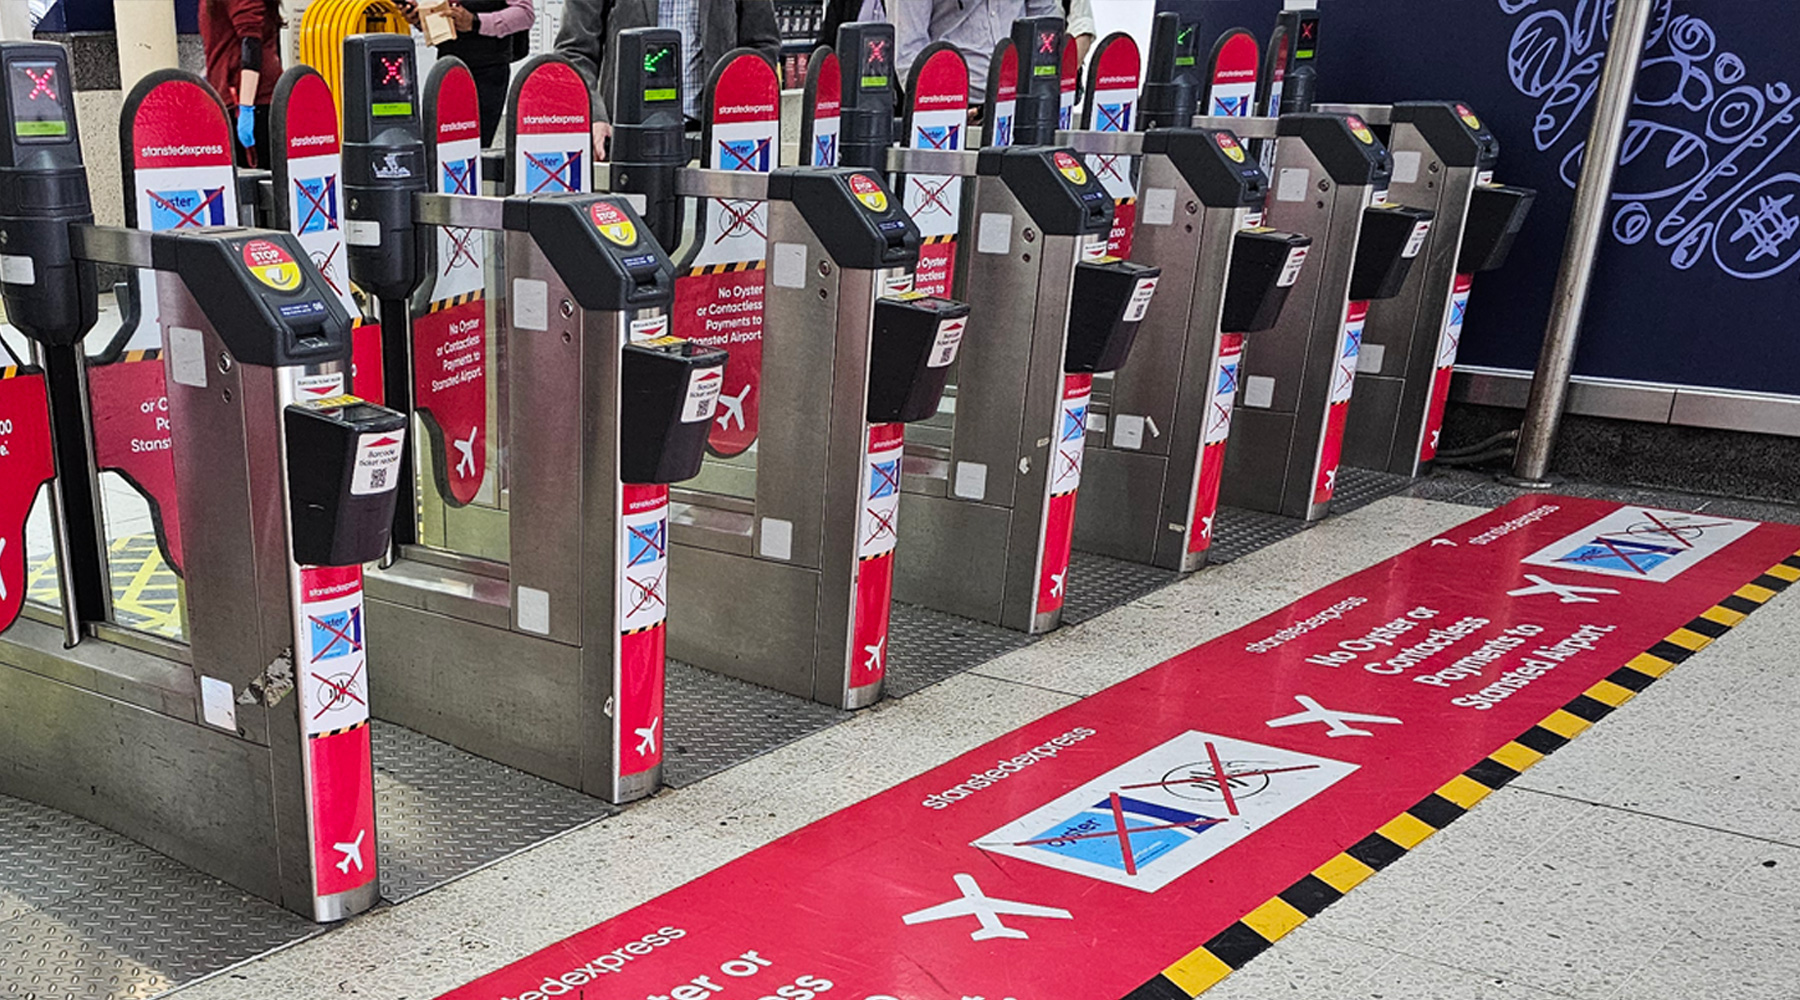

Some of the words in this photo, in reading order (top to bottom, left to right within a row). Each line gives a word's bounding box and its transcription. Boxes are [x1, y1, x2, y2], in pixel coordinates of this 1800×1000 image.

[523, 114, 585, 124] stanstedexpress
[141, 144, 223, 157] stanstedexpress
[155, 196, 194, 211] oyster
[251, 249, 279, 262] STOP
[922, 257, 947, 269] Oyster
[718, 287, 731, 299] No
[733, 285, 763, 299] Oyster
[696, 307, 707, 316] or
[708, 300, 763, 315] Contactless
[449, 323, 459, 335] No
[460, 319, 479, 333] Oyster
[706, 316, 750, 331] Payments
[752, 316, 762, 325] to
[436, 346, 443, 357] or
[444, 334, 480, 354] Contactless
[443, 354, 472, 371] Payments
[473, 351, 480, 361] to
[432, 373, 460, 392] Stansted
[141, 401, 155, 413] or
[1245, 597, 1368, 653] stanstedexpress
[1305, 651, 1357, 667] No
[1338, 617, 1418, 651] Oyster
[1407, 606, 1439, 619] or
[1364, 616, 1490, 675] Contactless
[1413, 635, 1526, 687] Payments
[1504, 624, 1544, 637] to
[1451, 657, 1558, 710] Stansted
[1532, 624, 1617, 662] Airport.
[922, 727, 1096, 810] stanstedexpress
[1047, 816, 1102, 848] oyster
[720, 950, 772, 978] or
